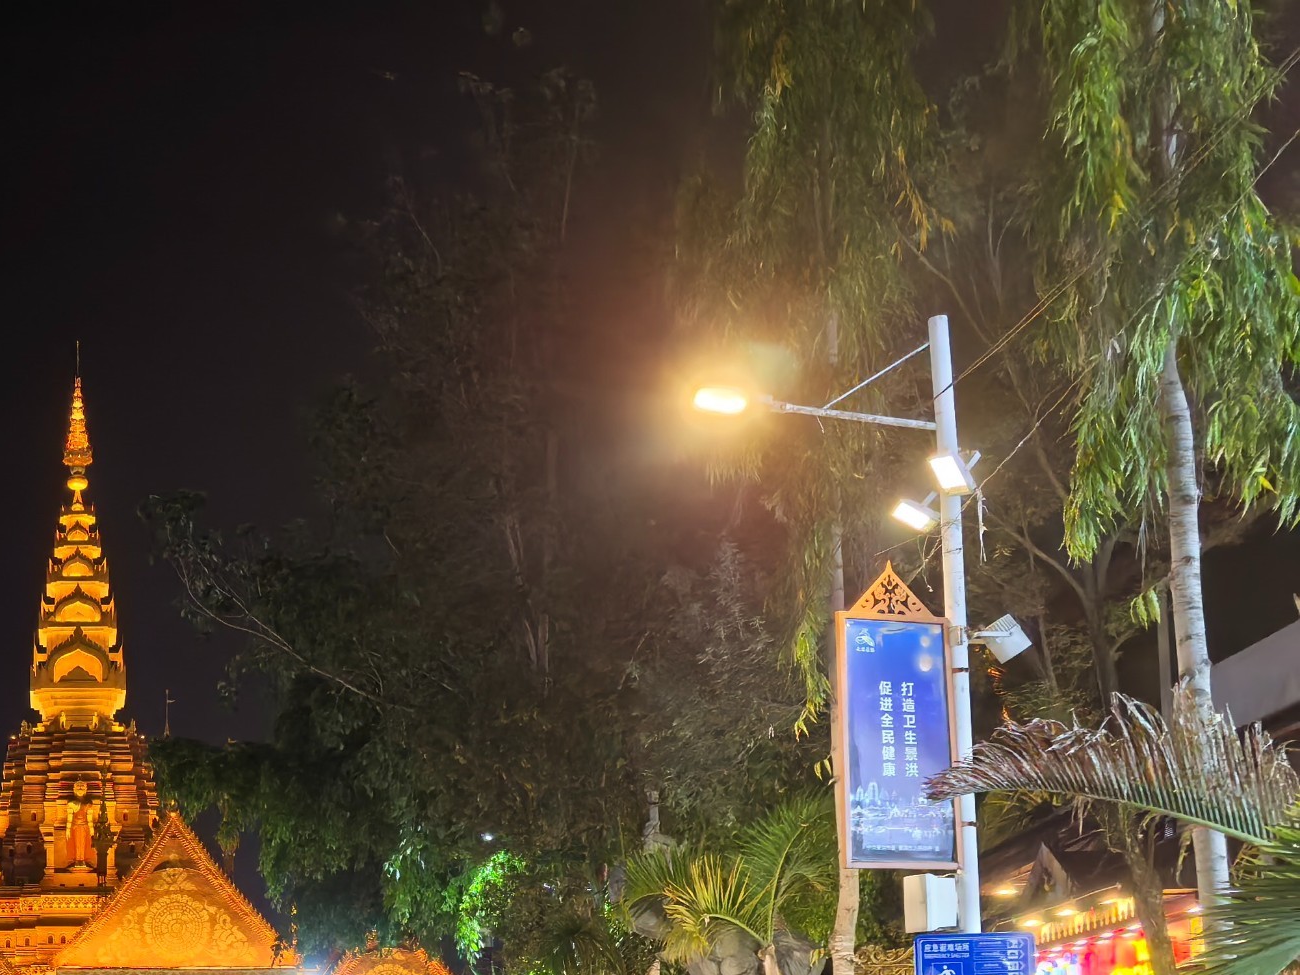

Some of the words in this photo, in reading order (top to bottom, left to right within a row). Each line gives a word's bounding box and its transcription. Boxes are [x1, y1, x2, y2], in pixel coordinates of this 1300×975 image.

[879, 680, 896, 777] 促进全民健康
[901, 681, 919, 777] 打造卫生景洪
